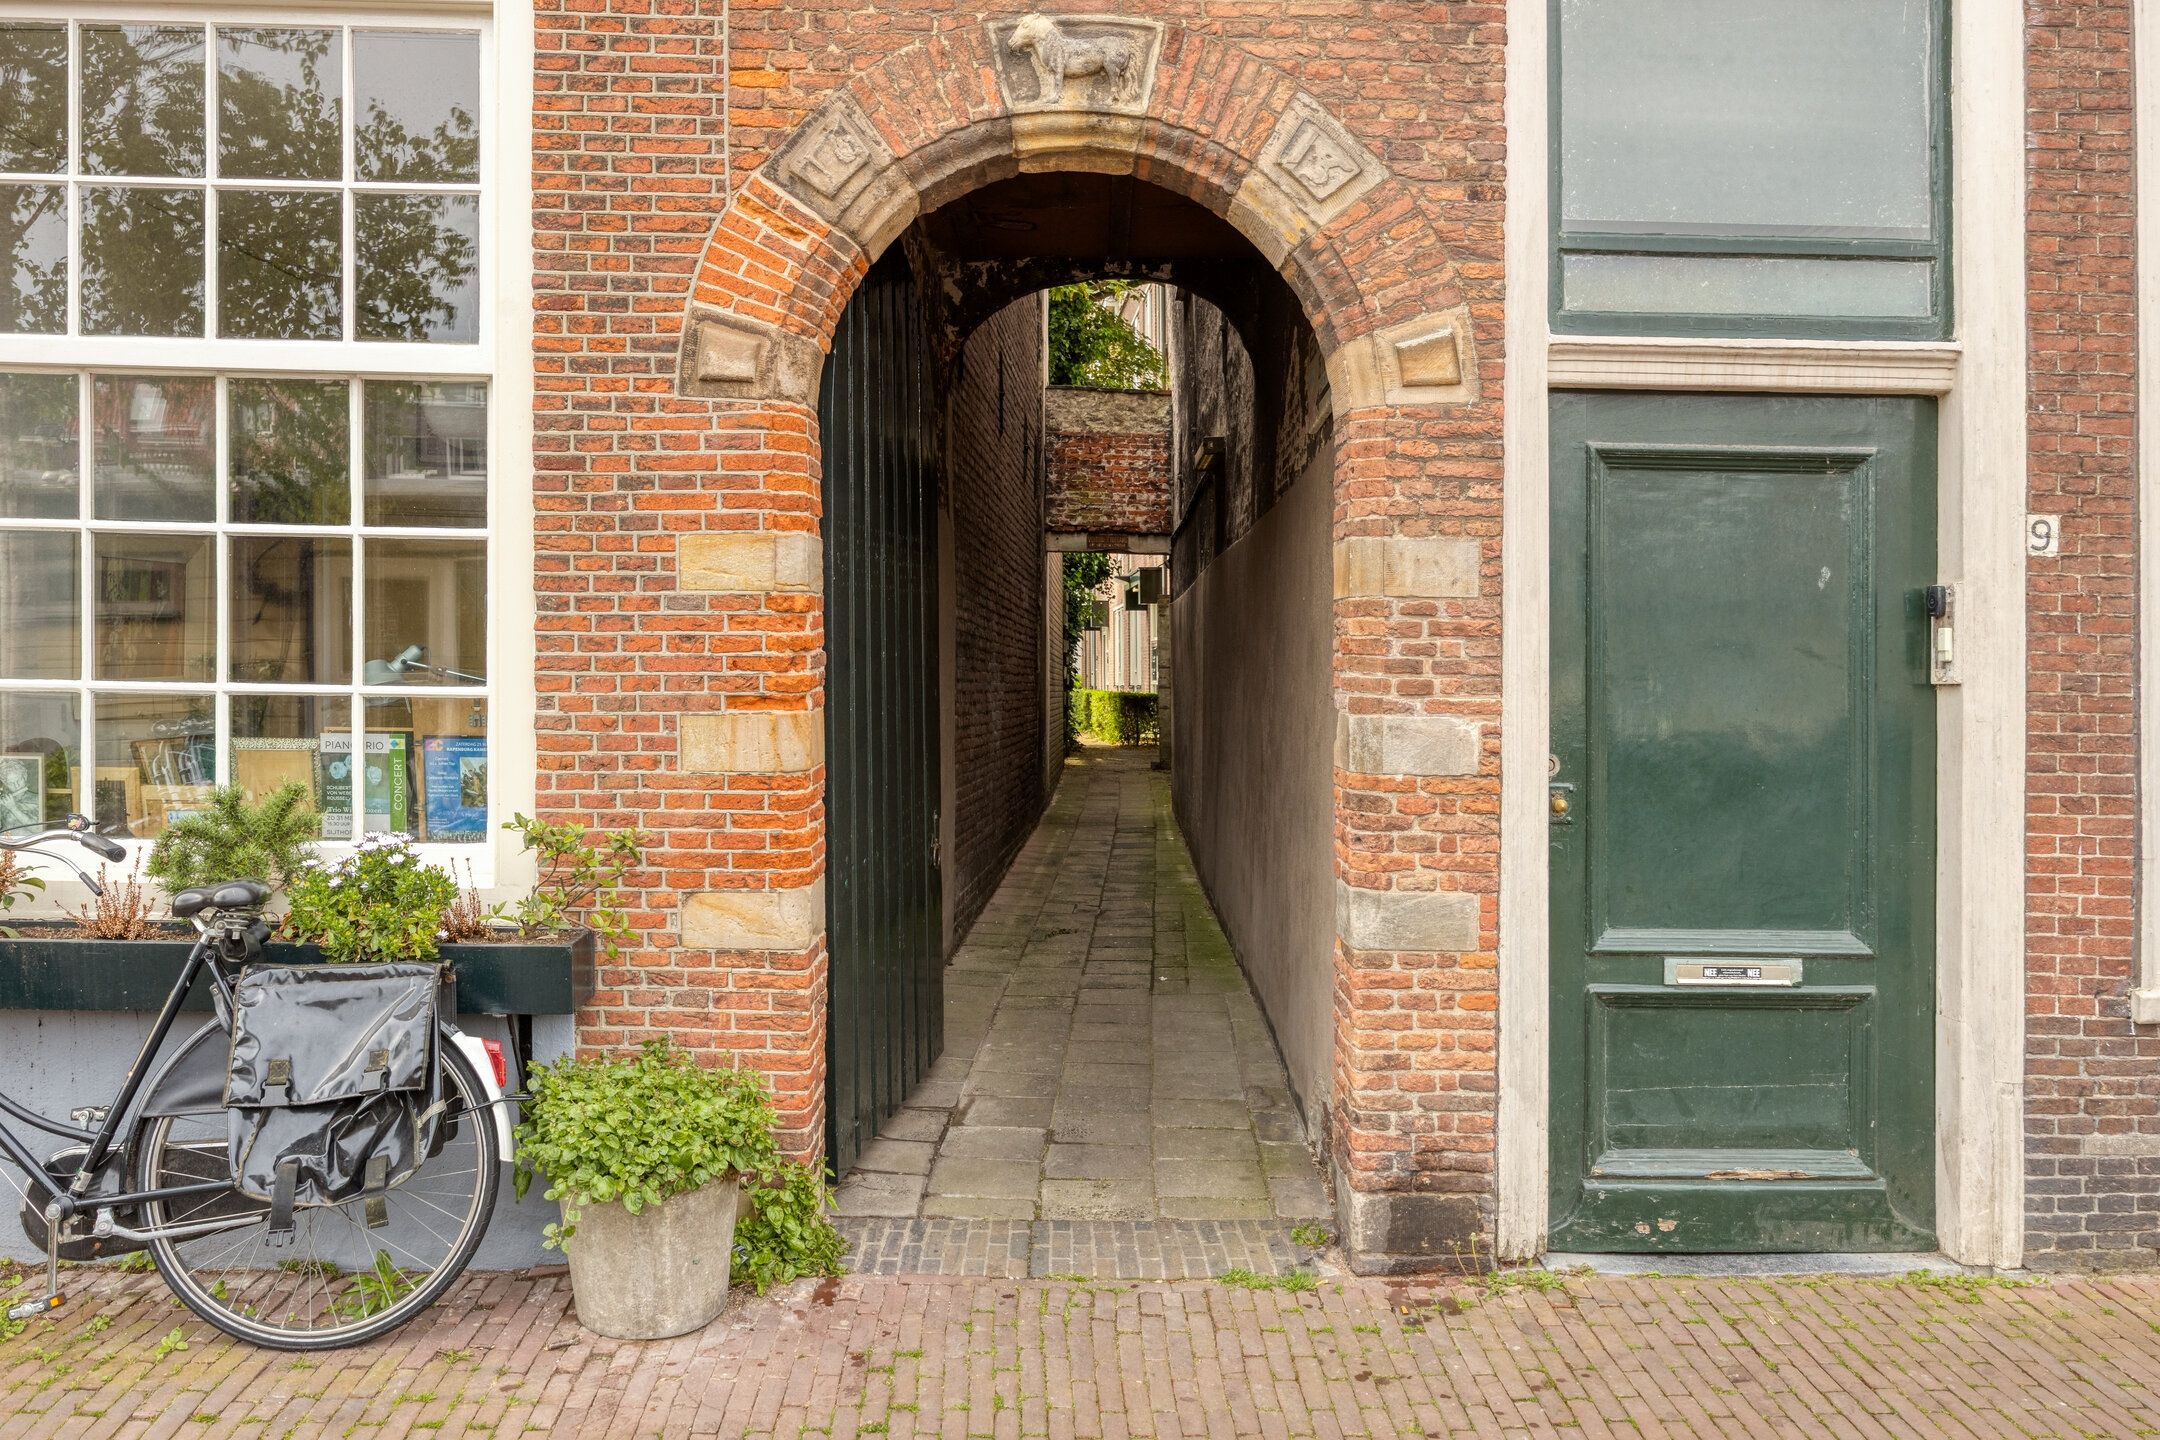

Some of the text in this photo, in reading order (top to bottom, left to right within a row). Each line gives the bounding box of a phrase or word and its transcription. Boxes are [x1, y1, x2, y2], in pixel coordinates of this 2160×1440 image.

[2030, 519, 2051, 551] 9
[325, 741, 384, 750] PIAN RIO
[393, 757, 403, 811] CONCERT
[1704, 968, 1717, 977] NEE
[1747, 969, 1760, 977] NEE
